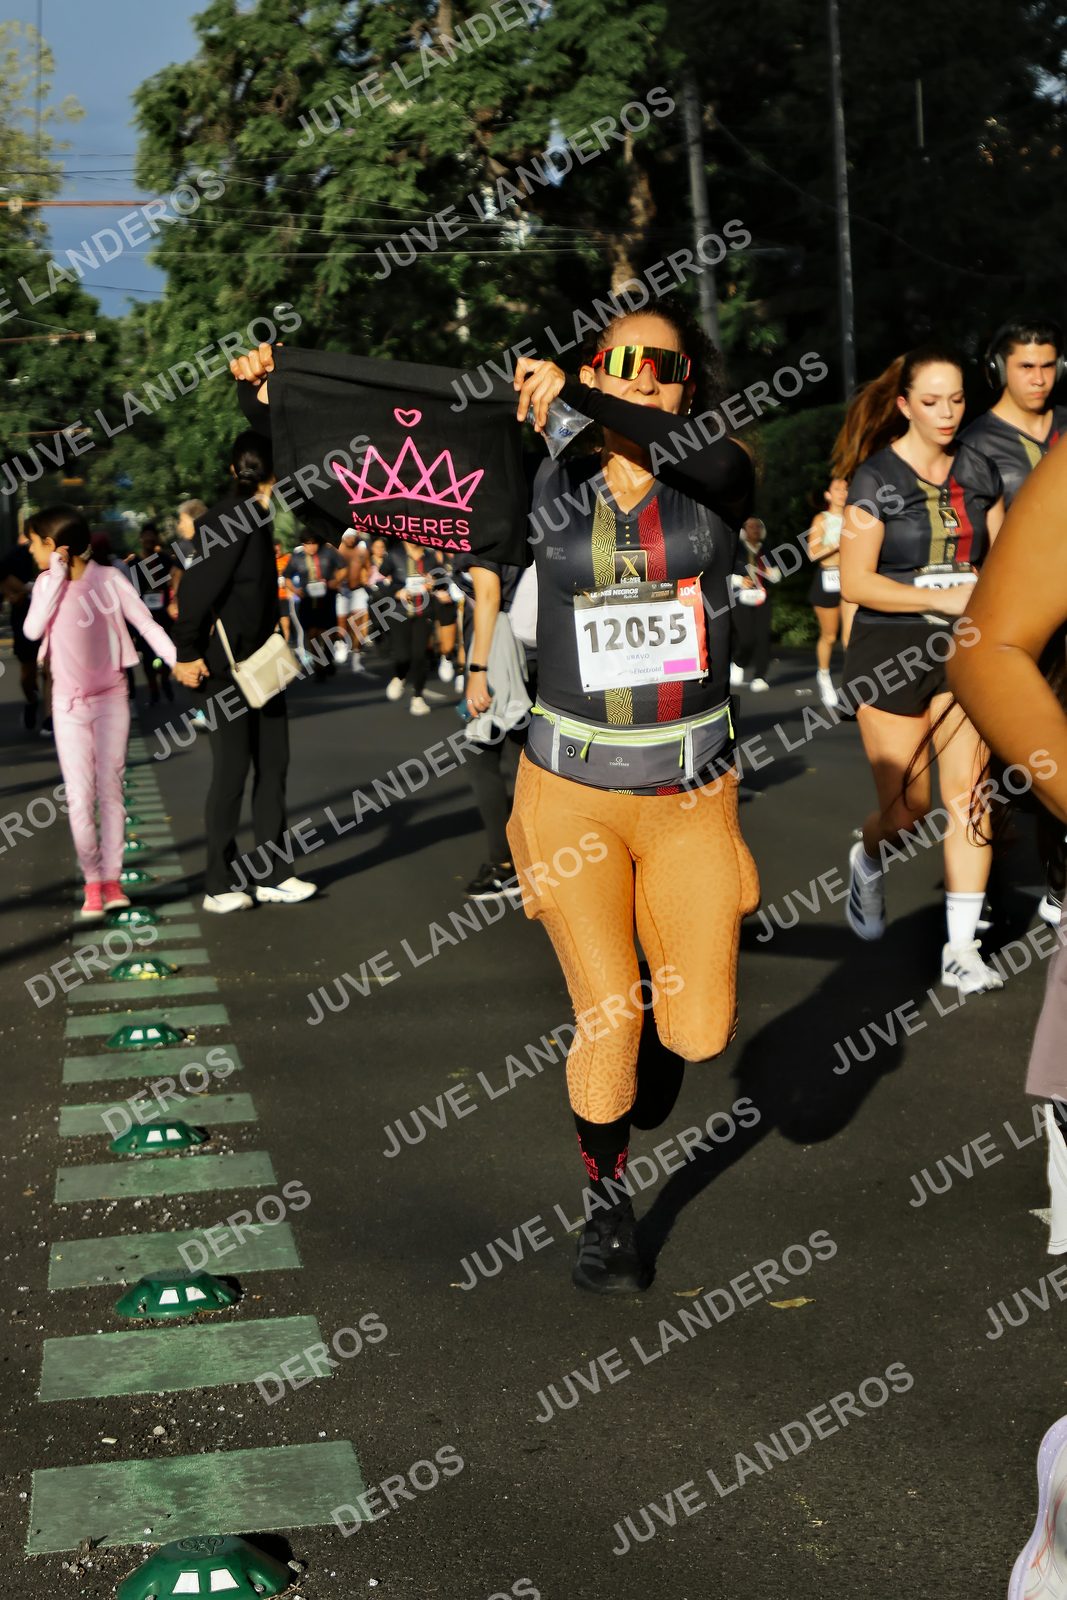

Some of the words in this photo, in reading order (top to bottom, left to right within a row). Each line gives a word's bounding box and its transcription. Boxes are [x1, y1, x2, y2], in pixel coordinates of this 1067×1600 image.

[352, 512, 470, 536] MUJERES
[355, 524, 472, 552] RERAS
[590, 590, 612, 598] LENES
[583, 613, 687, 653] 12055
